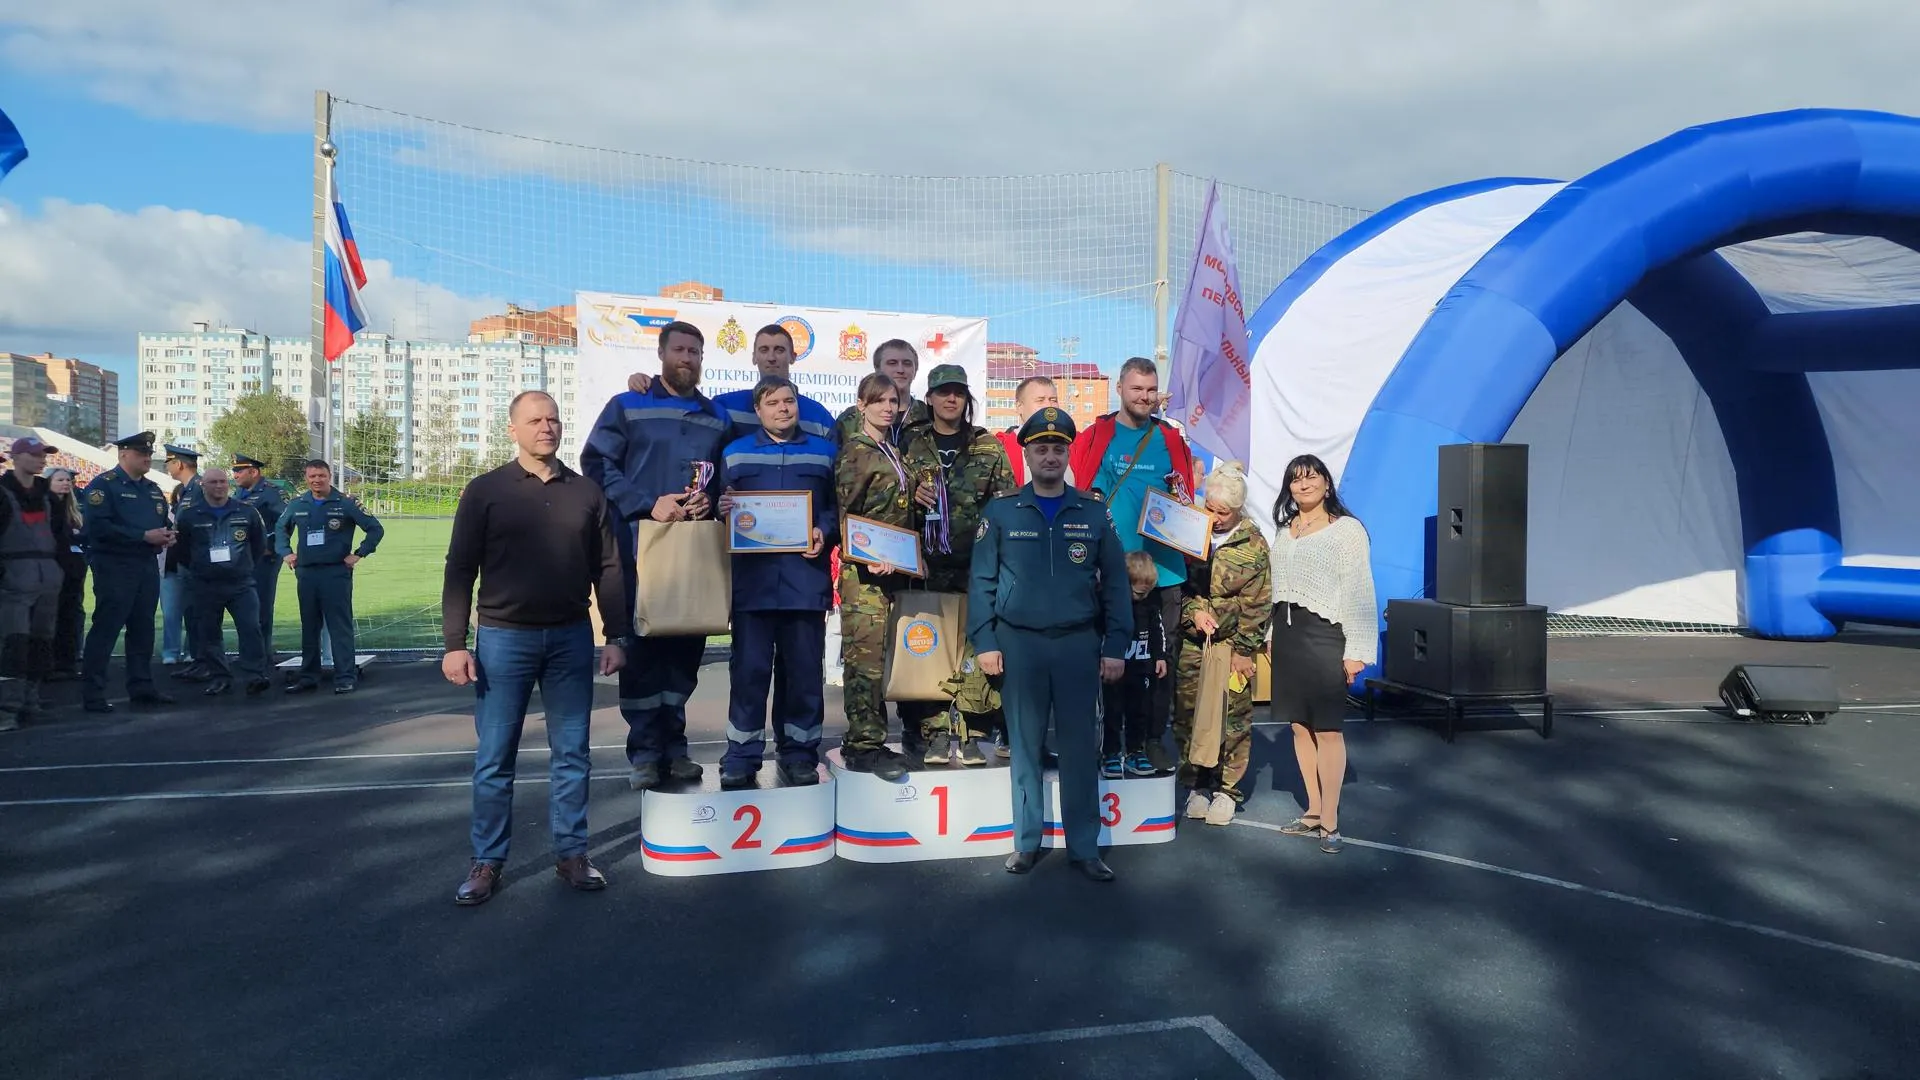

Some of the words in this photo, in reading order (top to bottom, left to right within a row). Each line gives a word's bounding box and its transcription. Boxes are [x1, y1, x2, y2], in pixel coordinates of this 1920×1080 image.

[789, 371, 863, 387] ЧЕМПИОН
[731, 804, 762, 850] 2
[929, 786, 948, 836] 1
[1100, 792, 1122, 827] 3
